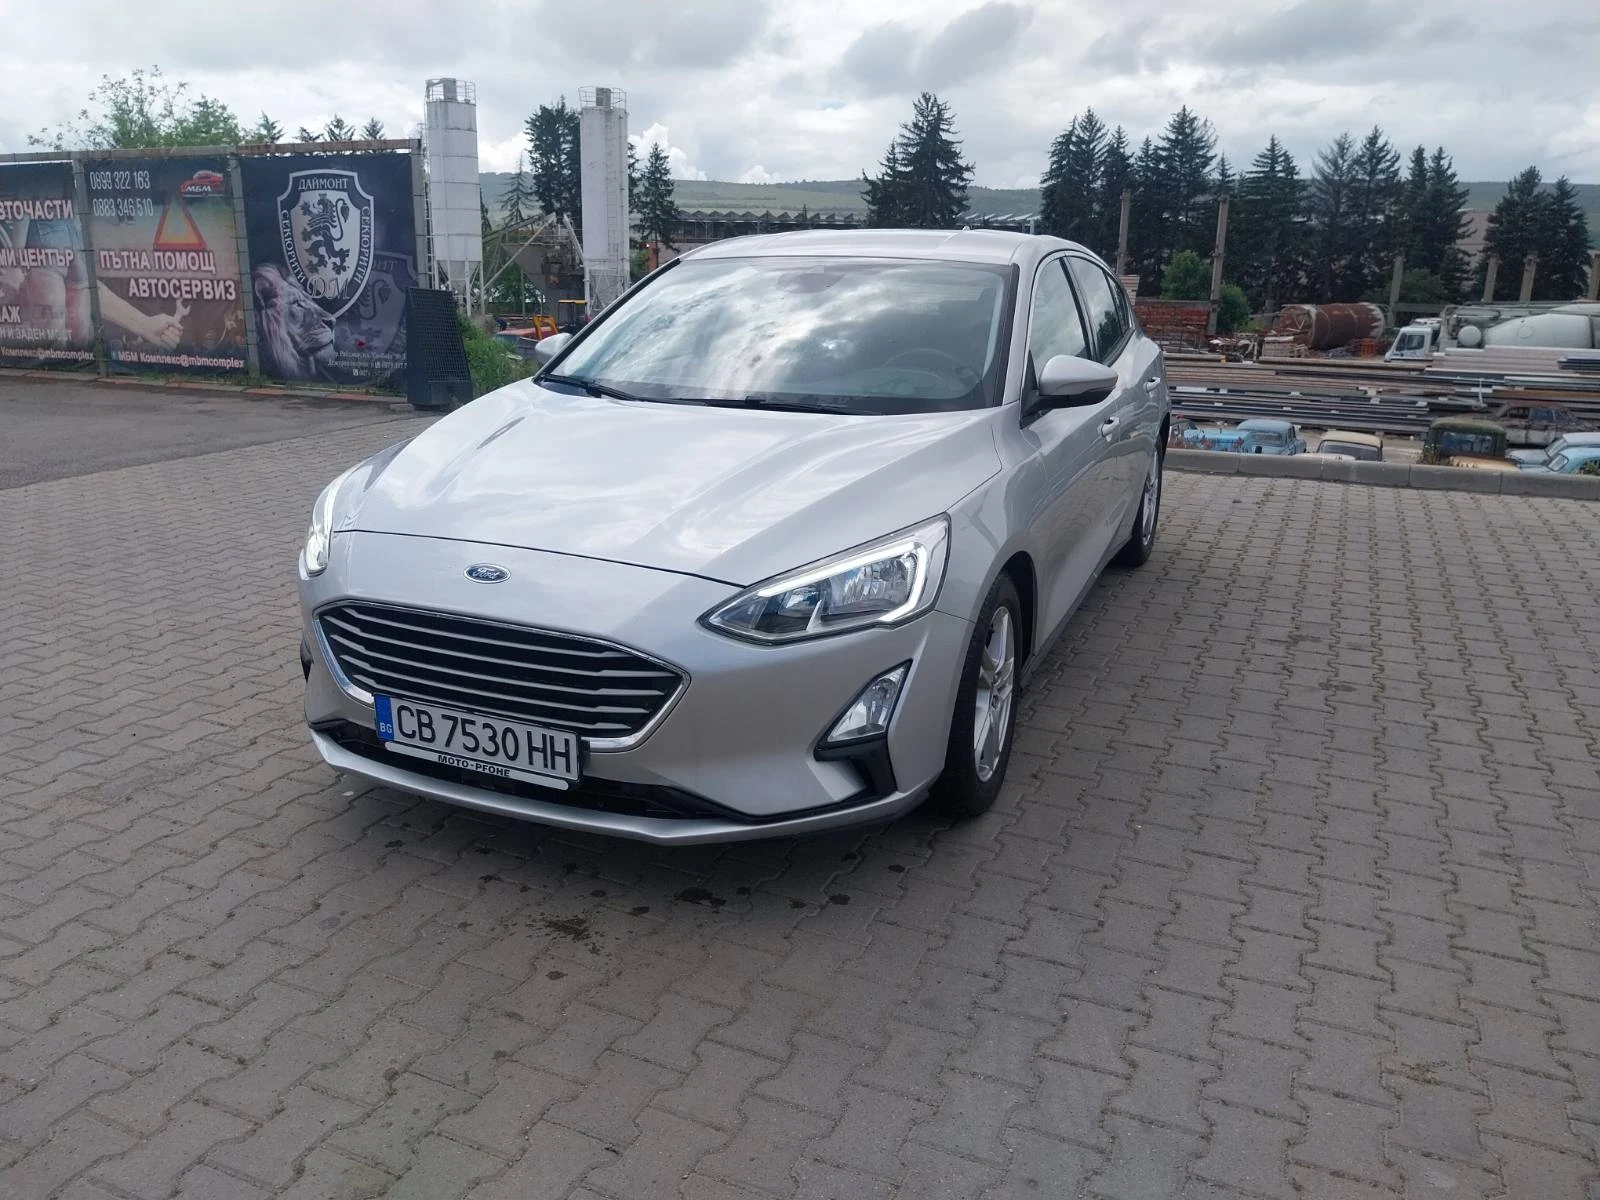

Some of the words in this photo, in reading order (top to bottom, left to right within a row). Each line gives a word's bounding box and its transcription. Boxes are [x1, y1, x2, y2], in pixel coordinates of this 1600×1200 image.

[89, 171, 112, 190] 0899
[113, 171, 131, 190] 322
[133, 170, 151, 190] 163
[298, 178, 349, 190] ДАЙМОНТ
[117, 198, 135, 217] 346
[136, 198, 154, 217] 510
[19, 248, 74, 270] ЦЕНТЪР
[100, 250, 151, 269] ПЪТНА
[153, 251, 216, 274] ПОМОЩ
[128, 278, 236, 300] АВТОСЕРВИЗ
[380, 722, 392, 734] BG
[441, 714, 519, 762] 7530
